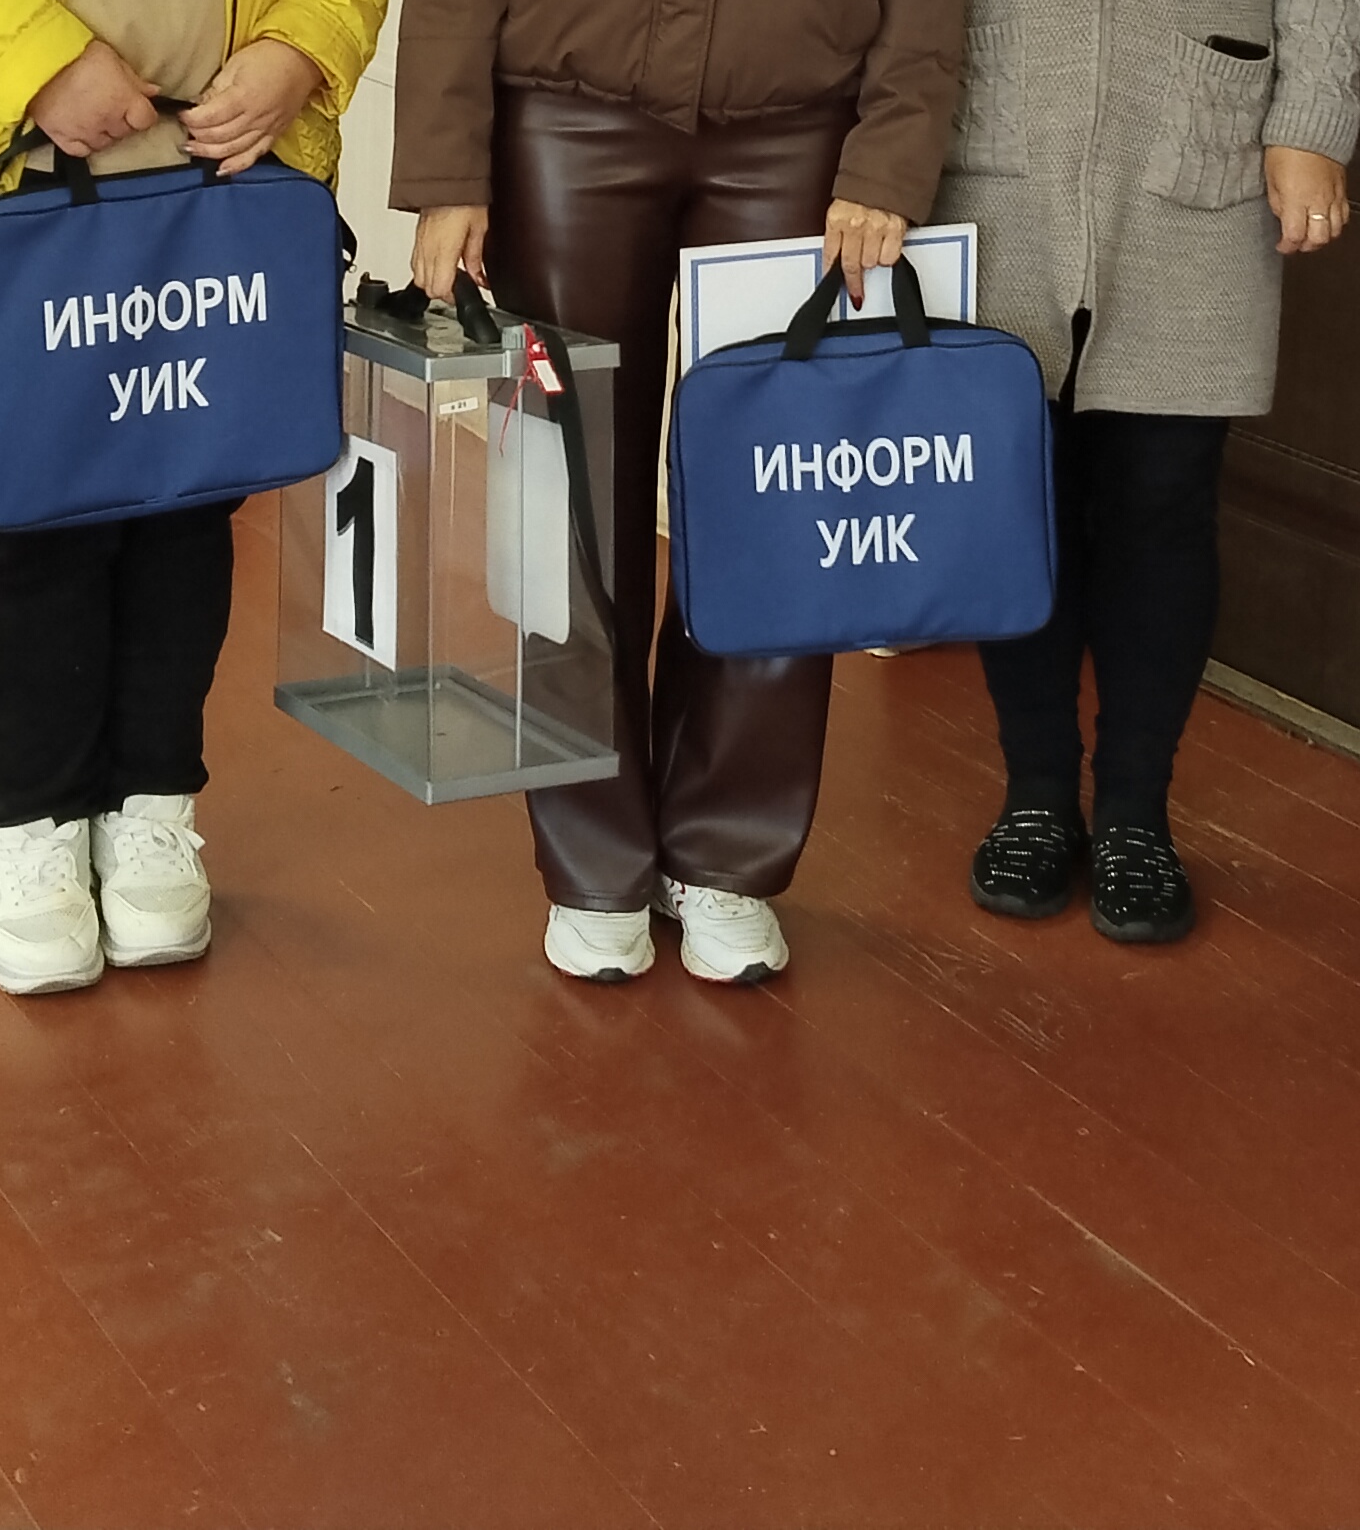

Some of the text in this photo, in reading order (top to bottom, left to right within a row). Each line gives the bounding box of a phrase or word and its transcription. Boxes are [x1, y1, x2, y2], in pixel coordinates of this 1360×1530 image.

[43, 272, 268, 351] ИНФОРМ
[108, 358, 209, 422] УИК
[753, 434, 974, 493] ИНФОРМ
[336, 456, 375, 650] 1
[816, 514, 919, 568] УИК
